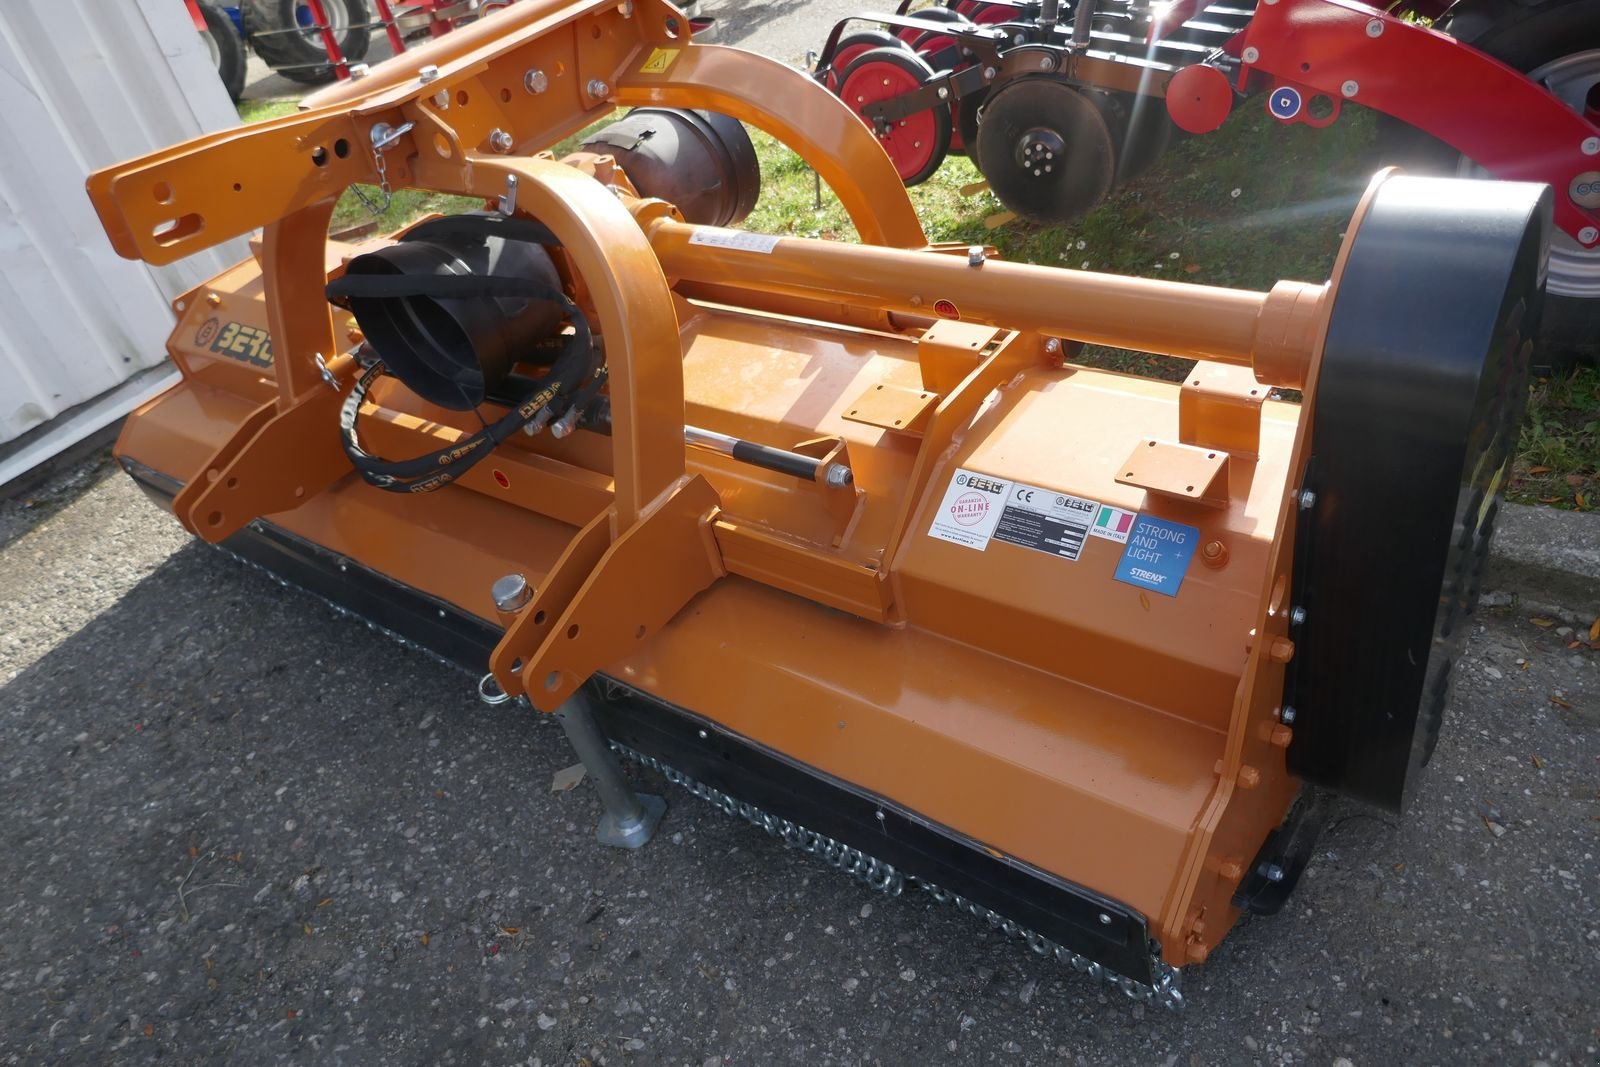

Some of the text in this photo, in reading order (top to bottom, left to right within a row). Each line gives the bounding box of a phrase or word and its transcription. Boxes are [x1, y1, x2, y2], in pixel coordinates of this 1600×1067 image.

[1016, 489, 1034, 503] CE
[950, 502, 990, 513] ON-LINE
[1111, 533, 1126, 541] ITALY
[1136, 522, 1186, 544] STRONG
[1131, 535, 1158, 550] AND
[1127, 546, 1163, 564] LIGHT
